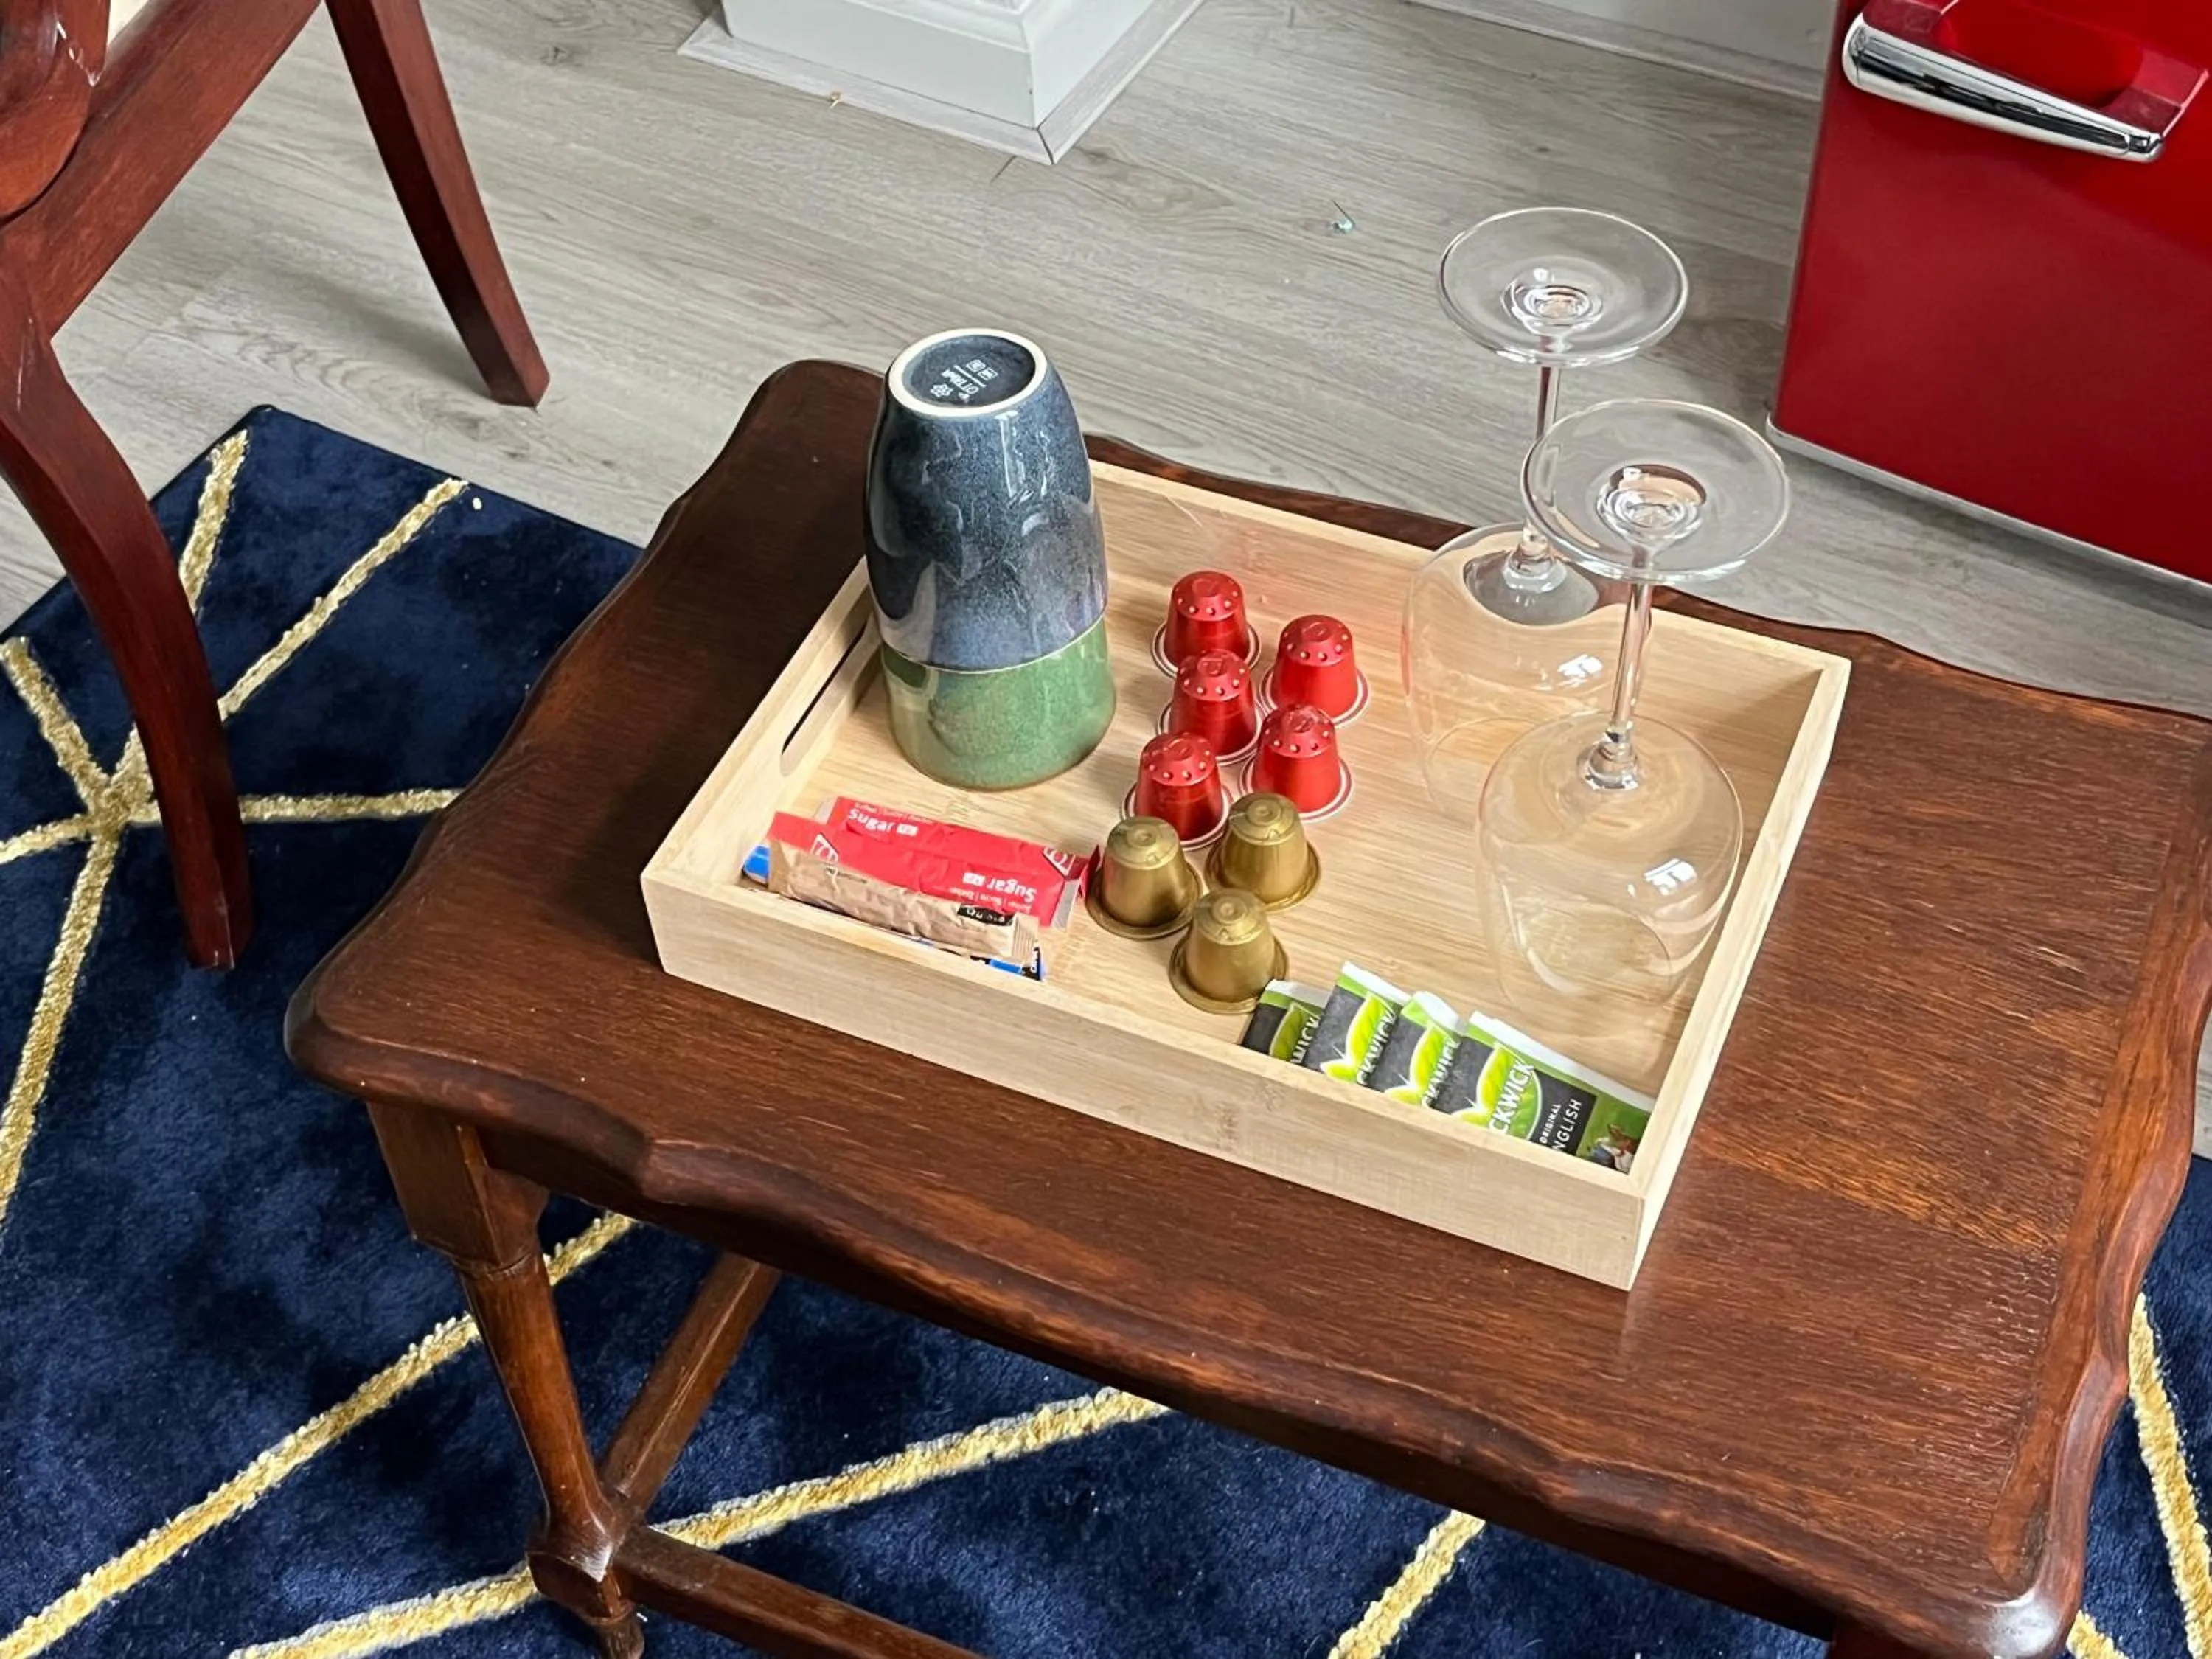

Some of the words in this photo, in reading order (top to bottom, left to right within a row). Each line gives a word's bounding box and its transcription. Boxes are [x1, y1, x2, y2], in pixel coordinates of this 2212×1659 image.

[849, 808, 896, 832] Sugar
[987, 878, 1037, 902] Sugar
[1489, 1060, 1534, 1134] CKWICK
[1539, 1103, 1562, 1144] ORIGINAL
[1551, 1098, 1582, 1150] NGLISH
